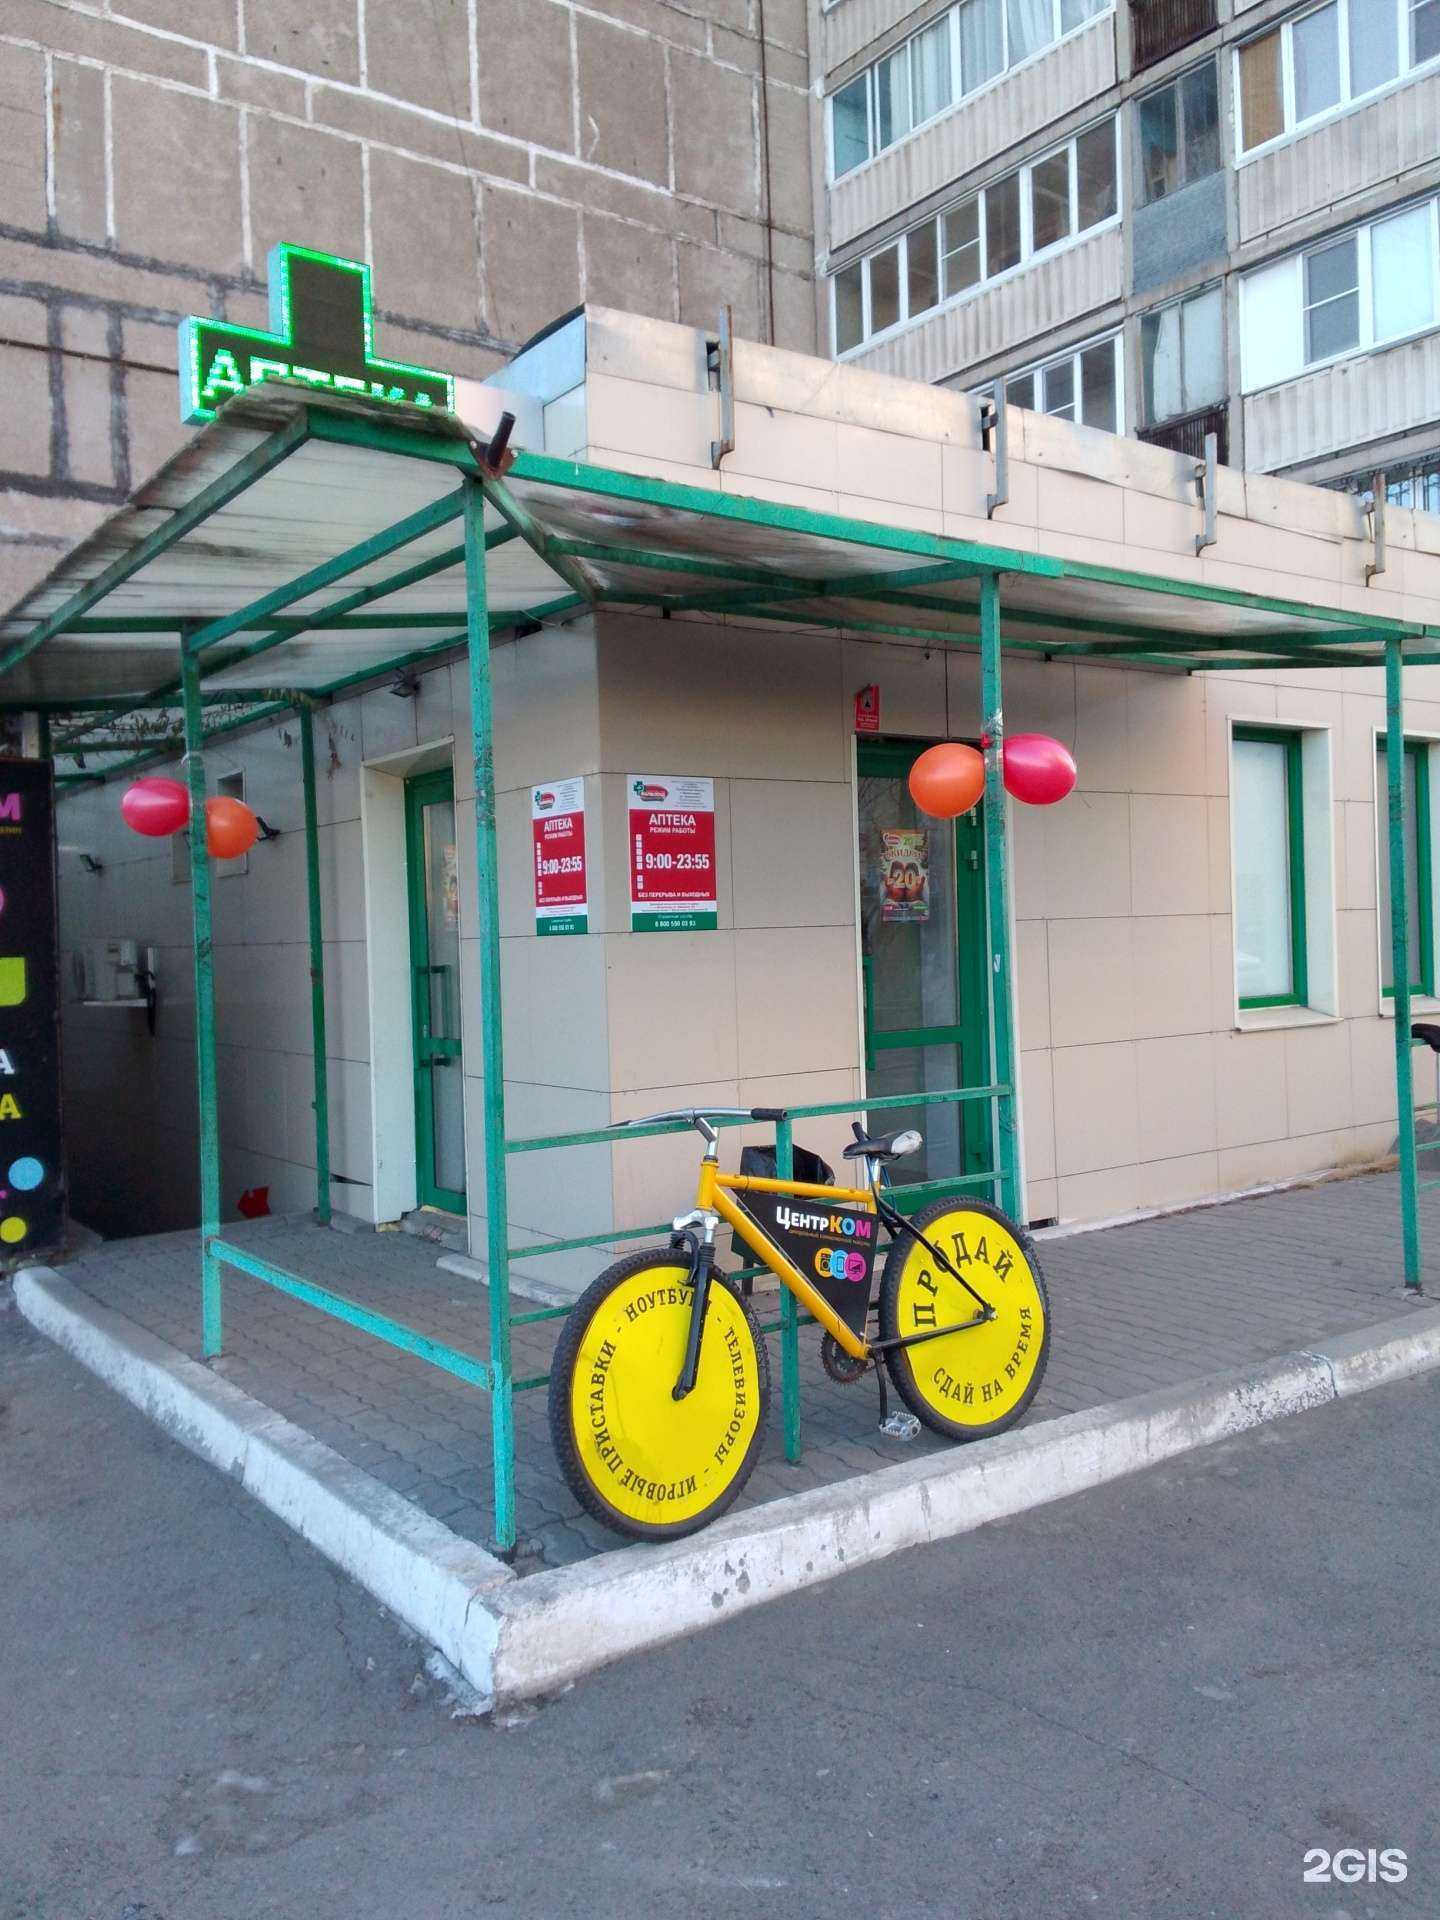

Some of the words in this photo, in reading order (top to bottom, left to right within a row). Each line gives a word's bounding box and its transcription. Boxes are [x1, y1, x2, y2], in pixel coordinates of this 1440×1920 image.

[544, 817, 573, 832] АПТЕКА
[649, 813, 696, 826] АПТЕКА
[672, 827, 696, 835] РАБОТЫ
[542, 855, 582, 875] 9:00-23:55
[645, 853, 710, 870] 9:00-23:55
[914, 1231, 1014, 1328] ПРОДАЙ
[933, 1367, 975, 1405] СДАЙ
[981, 1378, 1004, 1403] НА
[1004, 1306, 1032, 1381] ВРЕМЯ
[590, 1339, 623, 1474] ПРИСТАВКИ
[713, 1327, 746, 1465] ТЕЛЕВИЗОРЫ
[620, 1468, 698, 1501] ИГРОВЫЕ
